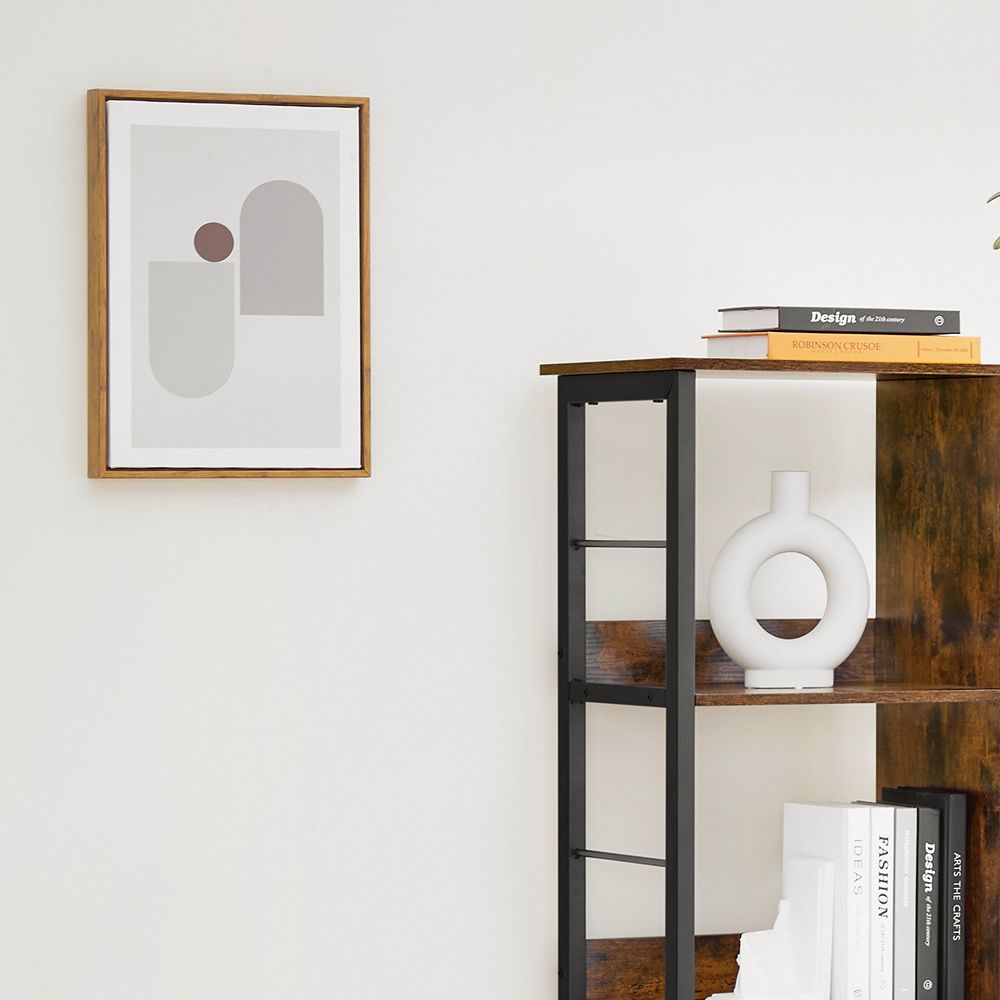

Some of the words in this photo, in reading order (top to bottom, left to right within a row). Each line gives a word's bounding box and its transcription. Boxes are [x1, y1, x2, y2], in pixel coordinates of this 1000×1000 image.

[810, 310, 857, 326] Design
[859, 315, 866, 323] of
[866, 315, 875, 323] the
[886, 316, 905, 325] century
[792, 339, 842, 351] ROBINSON
[843, 341, 881, 351] CRUSOE
[854, 839, 863, 896] IDEAS
[878, 835, 889, 919] FASHION
[922, 842, 936, 893] Design
[953, 852, 961, 877] ARTS
[953, 880, 961, 901] THE
[952, 904, 961, 941] CRAFTS
